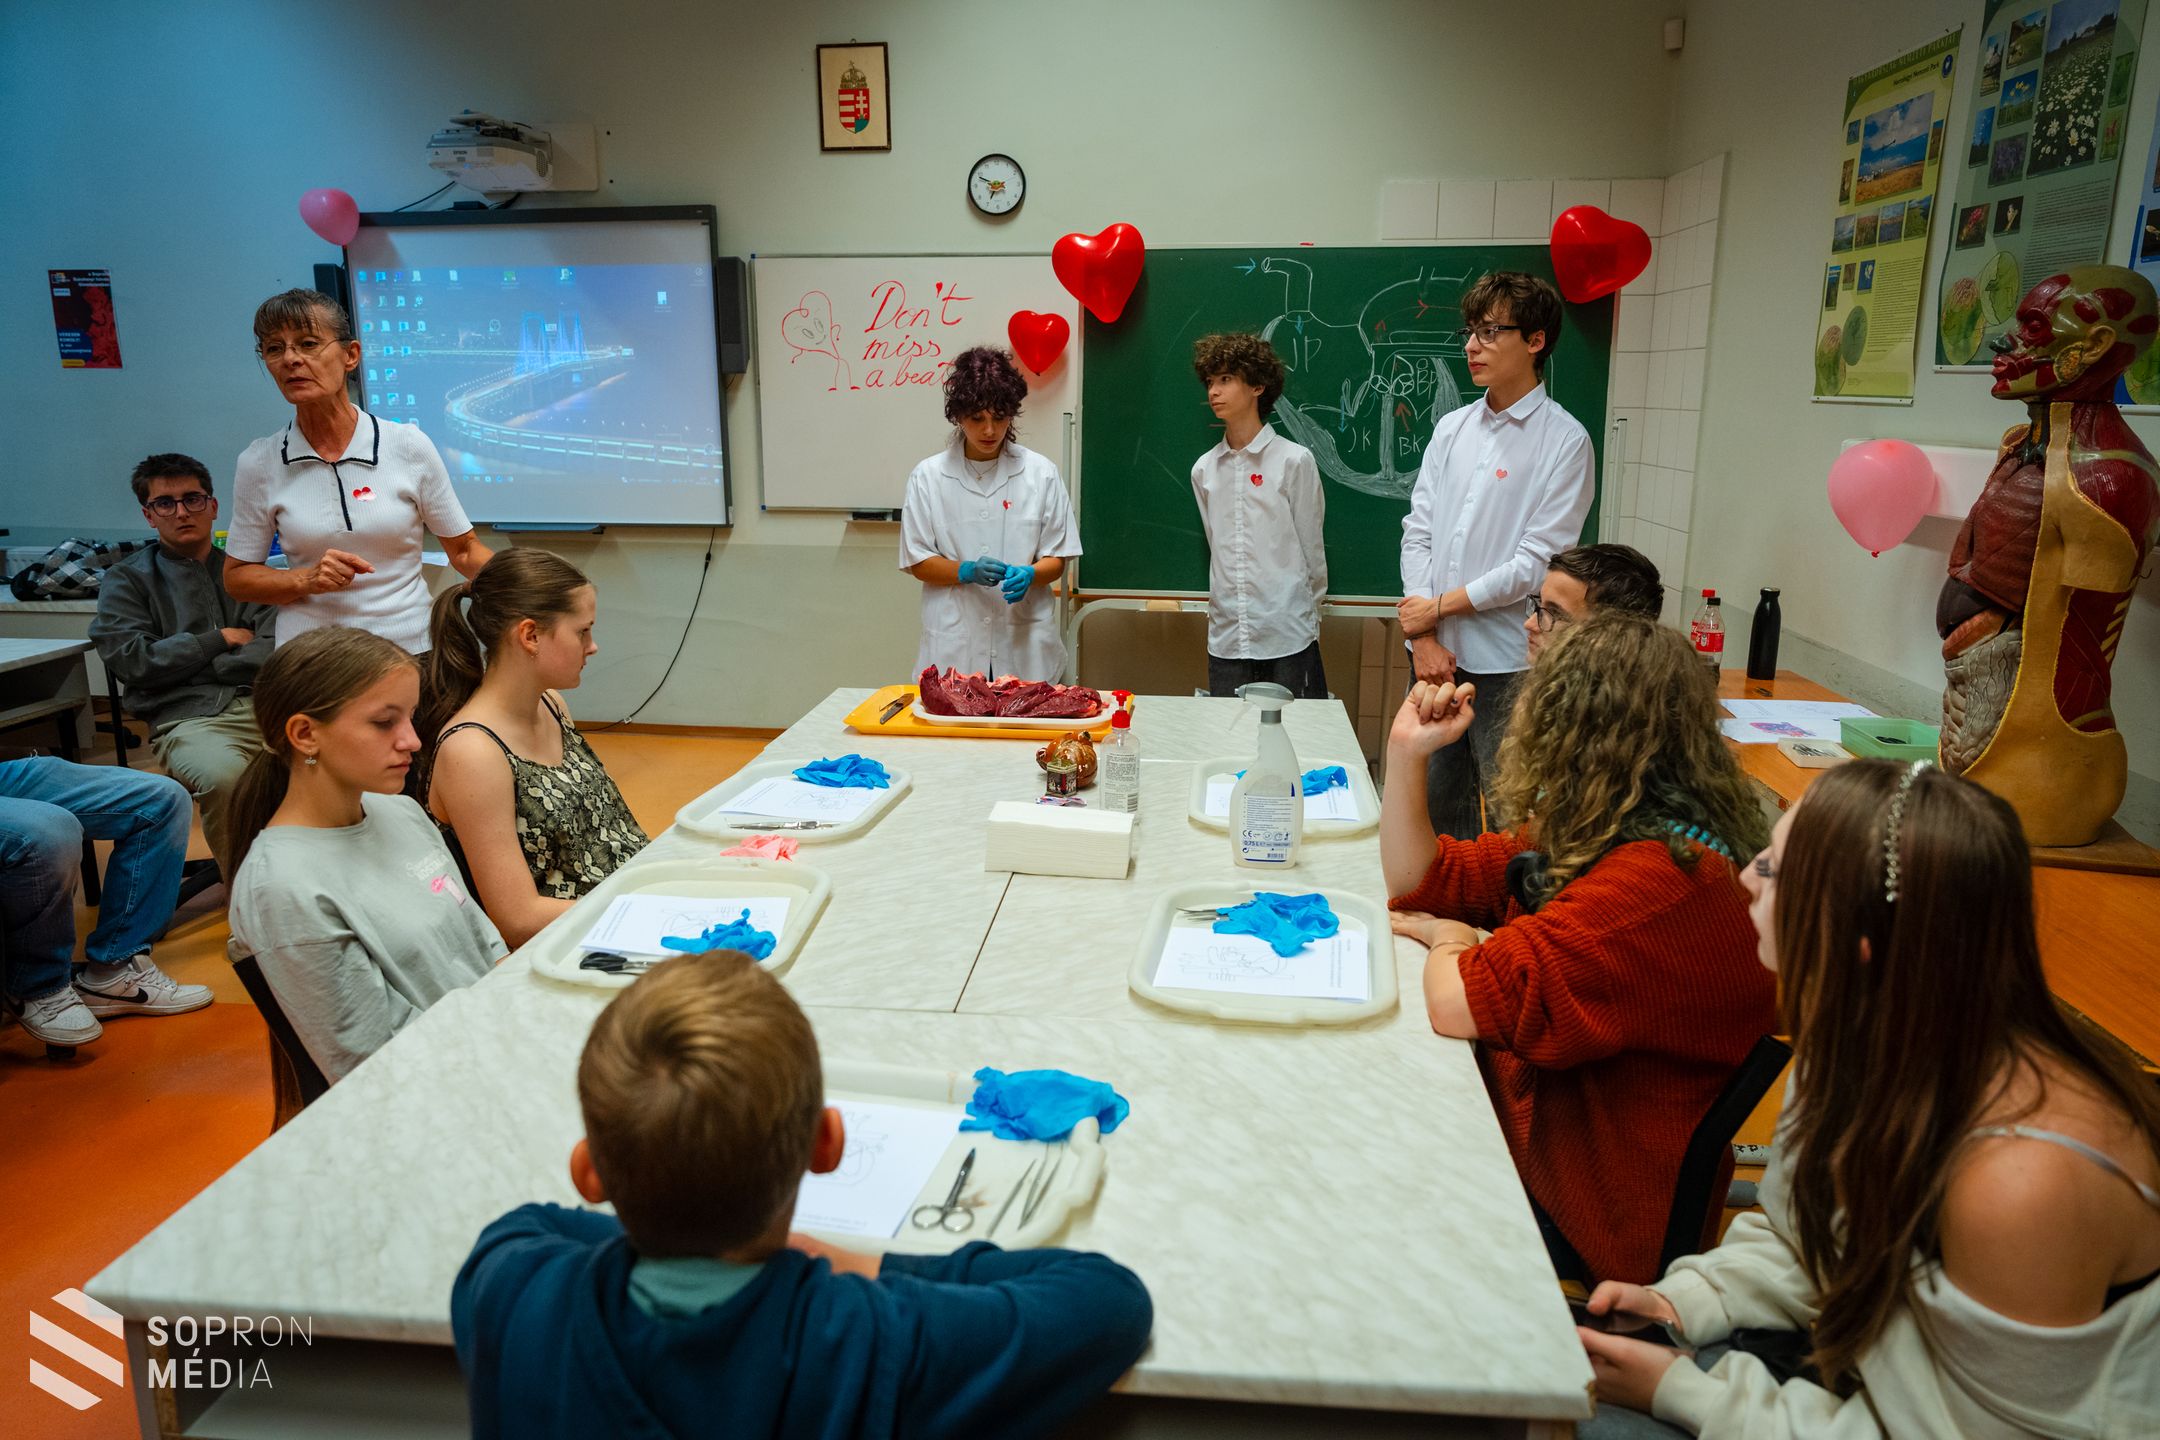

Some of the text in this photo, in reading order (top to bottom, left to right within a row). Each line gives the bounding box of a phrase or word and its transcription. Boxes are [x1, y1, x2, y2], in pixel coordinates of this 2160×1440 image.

[864, 279, 976, 333] Don't
[863, 334, 941, 361] miss
[865, 355, 956, 388] a beat
[1399, 433, 1424, 457] BK
